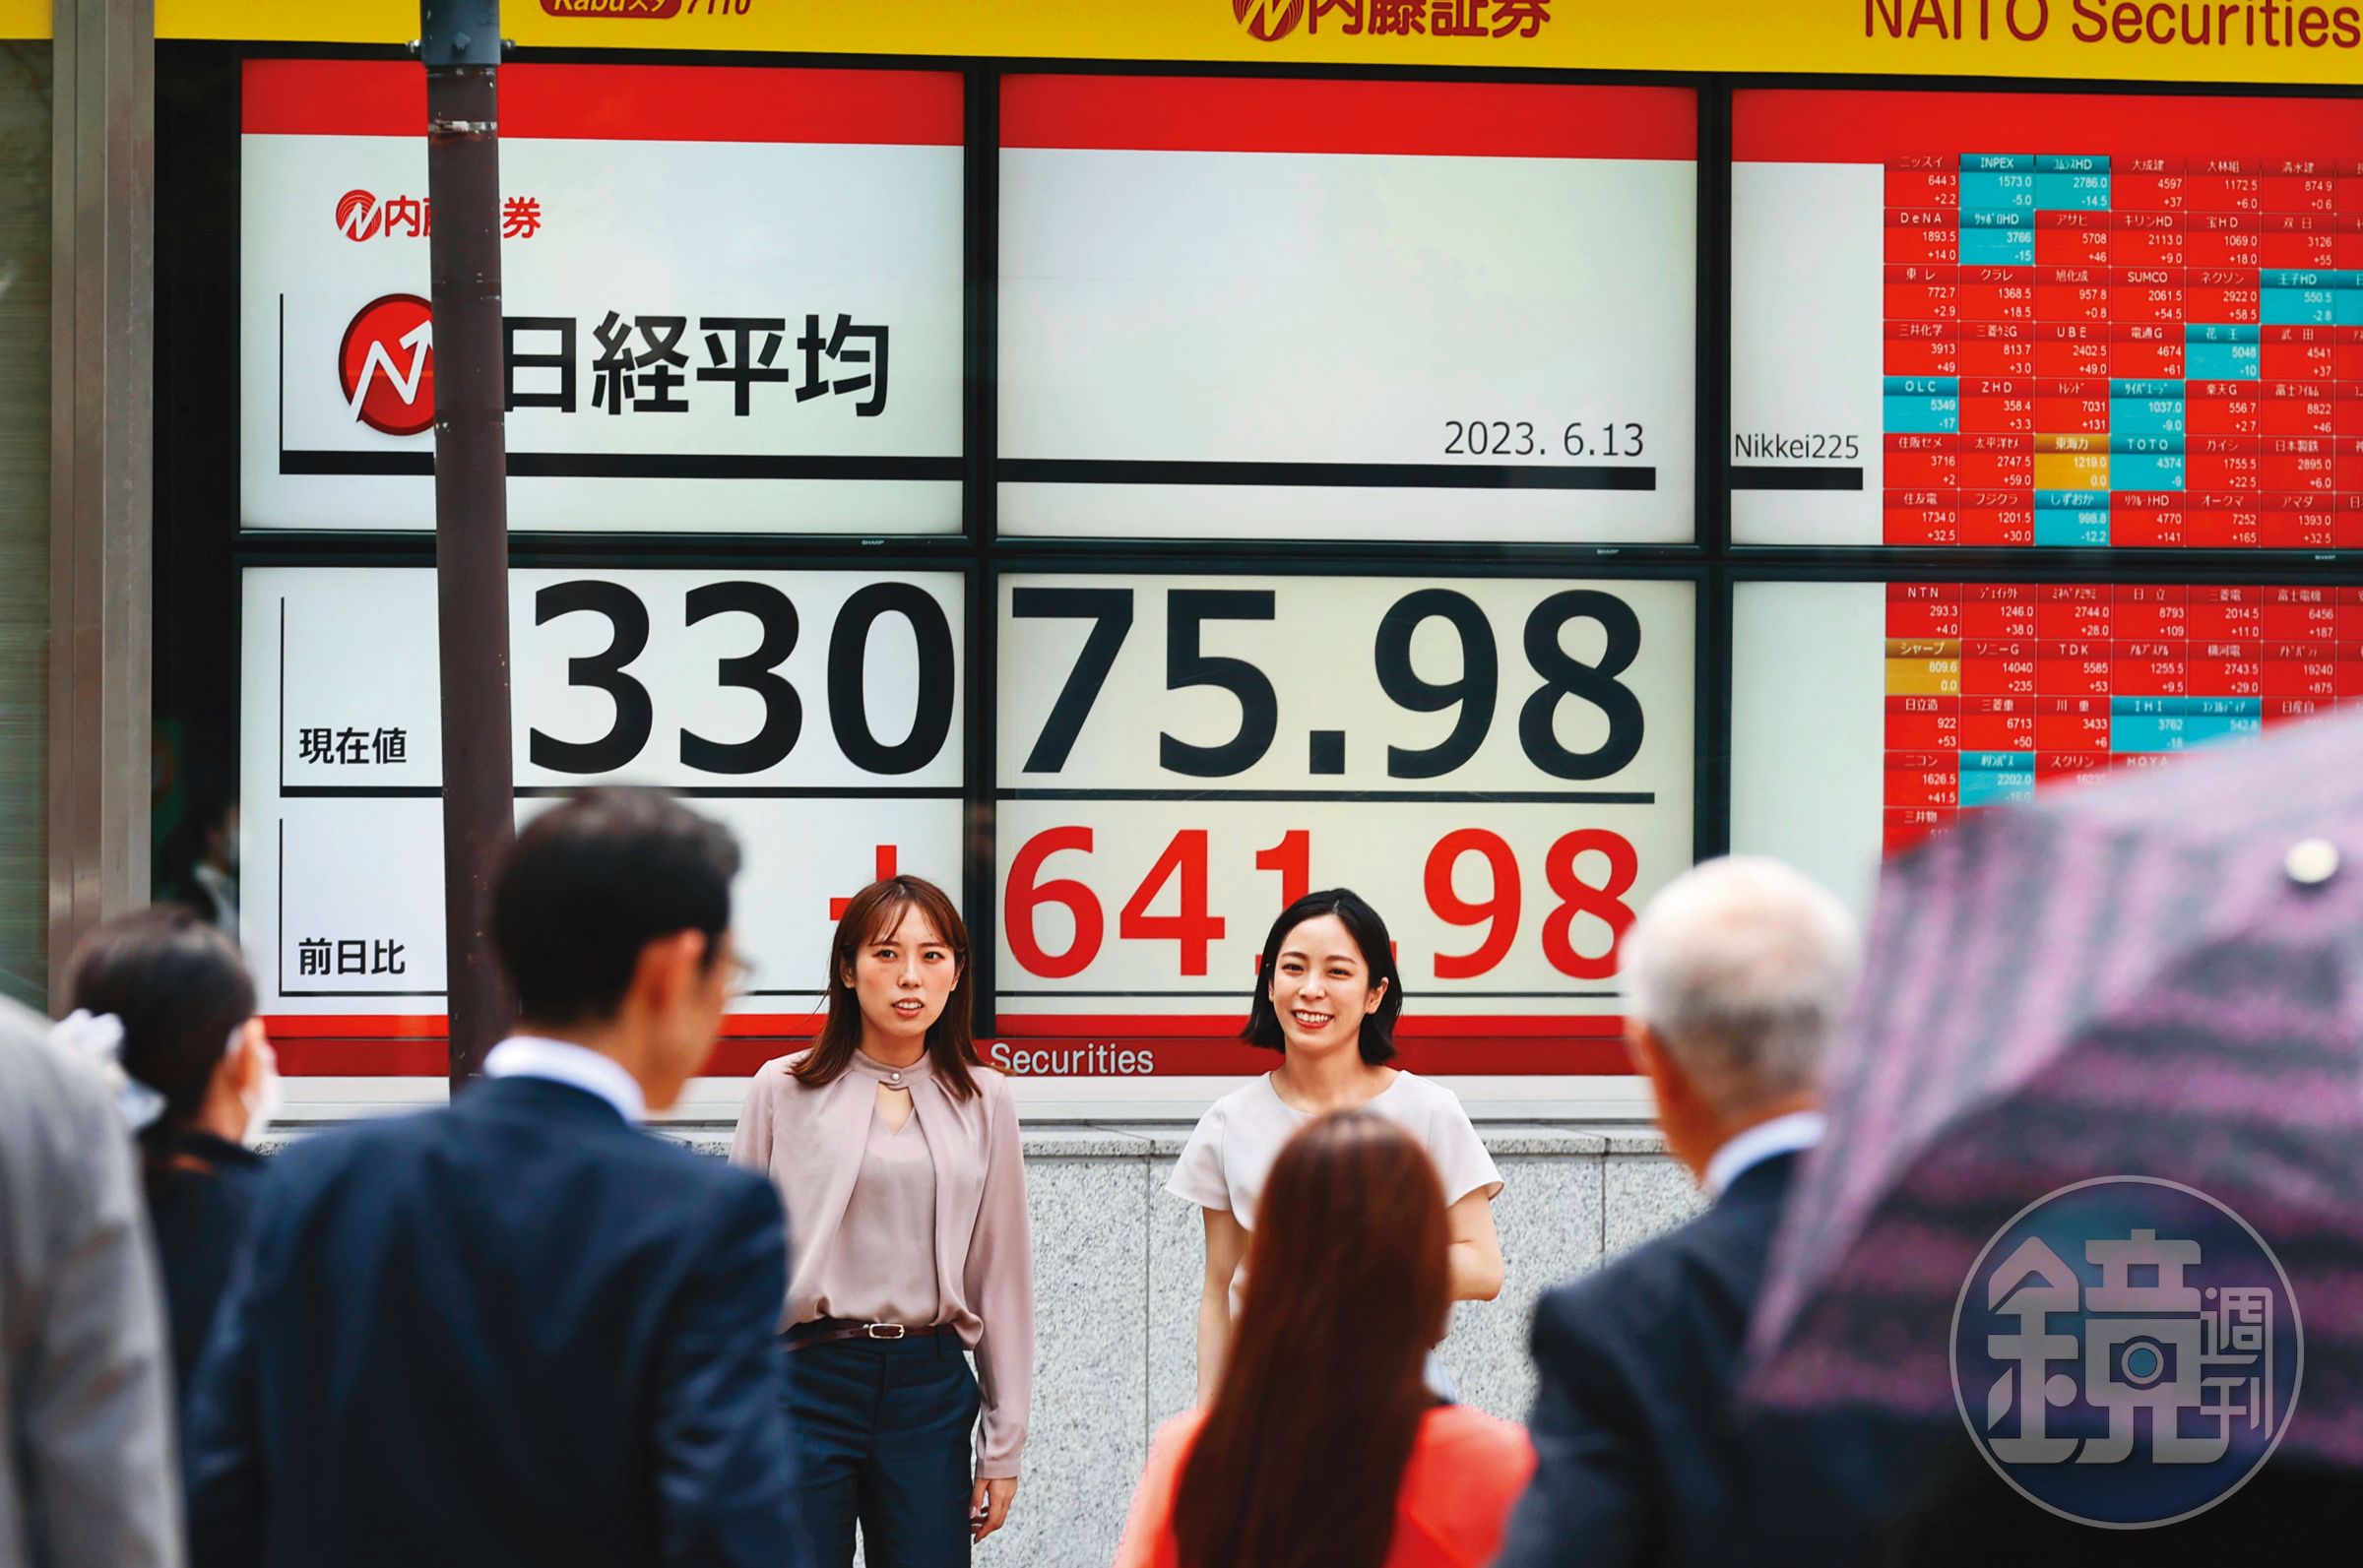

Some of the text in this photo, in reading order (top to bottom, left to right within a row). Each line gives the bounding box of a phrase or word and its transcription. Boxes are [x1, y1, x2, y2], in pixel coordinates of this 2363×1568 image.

[1865, 0, 2361, 48] NAITO Securities
[1900, 156, 1943, 167] ニッスイ
[1980, 157, 2013, 168] INPEX
[1928, 174, 1955, 185] 644.3
[1999, 174, 2031, 187] 1573.0
[2073, 176, 2107, 188] 2786.0
[2157, 177, 2182, 189] 4597
[1934, 193, 1955, 204] +2.2
[2012, 193, 2031, 205] -5.0
[2081, 194, 2107, 206] -14.5
[2163, 196, 2182, 207] +37
[384, 195, 542, 238] 内券
[2057, 214, 2086, 225] アサヒ
[2126, 215, 2172, 226] キリンHD
[2081, 232, 2106, 244] 5708
[2147, 233, 2182, 245] 2113.0
[2224, 234, 2257, 246] 1069.0
[2307, 235, 2331, 247] 3126
[1928, 249, 1955, 260] +14.0
[2014, 249, 2031, 261] -15
[2088, 251, 2106, 262] +46
[2314, 254, 2331, 266] +55
[1981, 269, 2012, 281] クラレ
[2127, 271, 2167, 282] SUMCO
[2201, 272, 2244, 283] ネクソン
[1928, 286, 1955, 298] 772.7
[1998, 287, 2031, 298] 1368.5
[1934, 305, 1955, 316] +2.9
[2003, 306, 2031, 317] +18.5
[2229, 308, 2257, 320] +58.5
[1931, 343, 1955, 354] 3913
[2003, 344, 2030, 354] 813.7
[2073, 345, 2106, 355] 2402.5
[2156, 345, 2181, 356] 4674
[2306, 346, 2331, 357] 4541
[502, 310, 890, 417] 日経平均
[1937, 361, 1955, 372] +49
[2010, 362, 2031, 373] +3.0
[2078, 363, 2106, 374] +49.0
[2163, 363, 2180, 375] +61
[2240, 363, 2259, 376] -10
[2313, 364, 2331, 376] +37
[2206, 383, 2237, 395] 楽天G
[2004, 400, 2030, 410] 358.4
[2081, 401, 2105, 411] 7031
[2148, 401, 2182, 413] 1037.0
[2306, 403, 2331, 414] 8822
[1939, 416, 1955, 428] -17
[2009, 418, 2031, 429] +3.3
[2081, 418, 2105, 429] +131
[2162, 418, 2182, 431] -9.0
[2313, 421, 2331, 432] +46
[1443, 420, 1644, 457] 2023. 6.13
[1735, 434, 1860, 460] Nikkei225
[1930, 455, 1955, 467] 3716
[1997, 455, 2030, 467] 2747.5
[2156, 457, 2181, 469] 4374
[1943, 473, 1955, 485] +2
[2003, 473, 2031, 485] +59.0
[2172, 474, 2182, 487] -9
[2228, 475, 2256, 487] +22.5
[2309, 476, 2331, 488] +6.0
[1903, 492, 1937, 504] 住友電
[1976, 493, 2017, 505] フジクラ
[2202, 494, 2243, 506] オークマ
[1922, 511, 1955, 523] 1734.0
[1998, 511, 2031, 523] 1201.5
[2156, 512, 2181, 524] 4770
[2232, 513, 2256, 525] 7252
[1927, 529, 1955, 540] +32.5
[2003, 530, 2031, 541] +30.0
[2080, 530, 2106, 542] -12.2
[2157, 532, 2180, 540] +141
[2232, 532, 2256, 542] +165
[1929, 604, 1957, 616] 293.3
[2001, 605, 2033, 616] 1246.0
[2075, 605, 2109, 617] 2744.0
[2158, 606, 2184, 618] 8793
[2308, 608, 2333, 619] 6456
[1936, 623, 1957, 634] +4.0
[2006, 623, 2033, 635] +38.0
[2080, 624, 2109, 636] +28.0
[2159, 625, 2184, 636] +109
[2309, 626, 2333, 637] +187
[1900, 641, 1945, 654] シャープ
[1976, 643, 2018, 655] ソニーG
[2003, 661, 2032, 672] 14040
[2083, 661, 2108, 673] 5585
[2303, 663, 2332, 675] 19240
[1940, 679, 1957, 691] 0.0
[2008, 679, 2032, 691] +235
[2088, 680, 2108, 692] +53
[2162, 680, 2183, 692] +9.5
[2308, 681, 2332, 693] +875
[1937, 717, 1955, 728] 922
[2007, 718, 2032, 728] 6713
[2082, 718, 2107, 729] 3433
[299, 726, 407, 764] 現在値
[1937, 735, 1956, 746] +53
[2013, 735, 2032, 747] +50
[2094, 736, 2107, 747] +6
[1905, 755, 1937, 766] ニコン
[1923, 773, 1955, 784] 1626.5
[1928, 791, 1955, 803] +41.5
[298, 937, 406, 975] 前日比
[990, 1042, 1124, 1074] Securities
